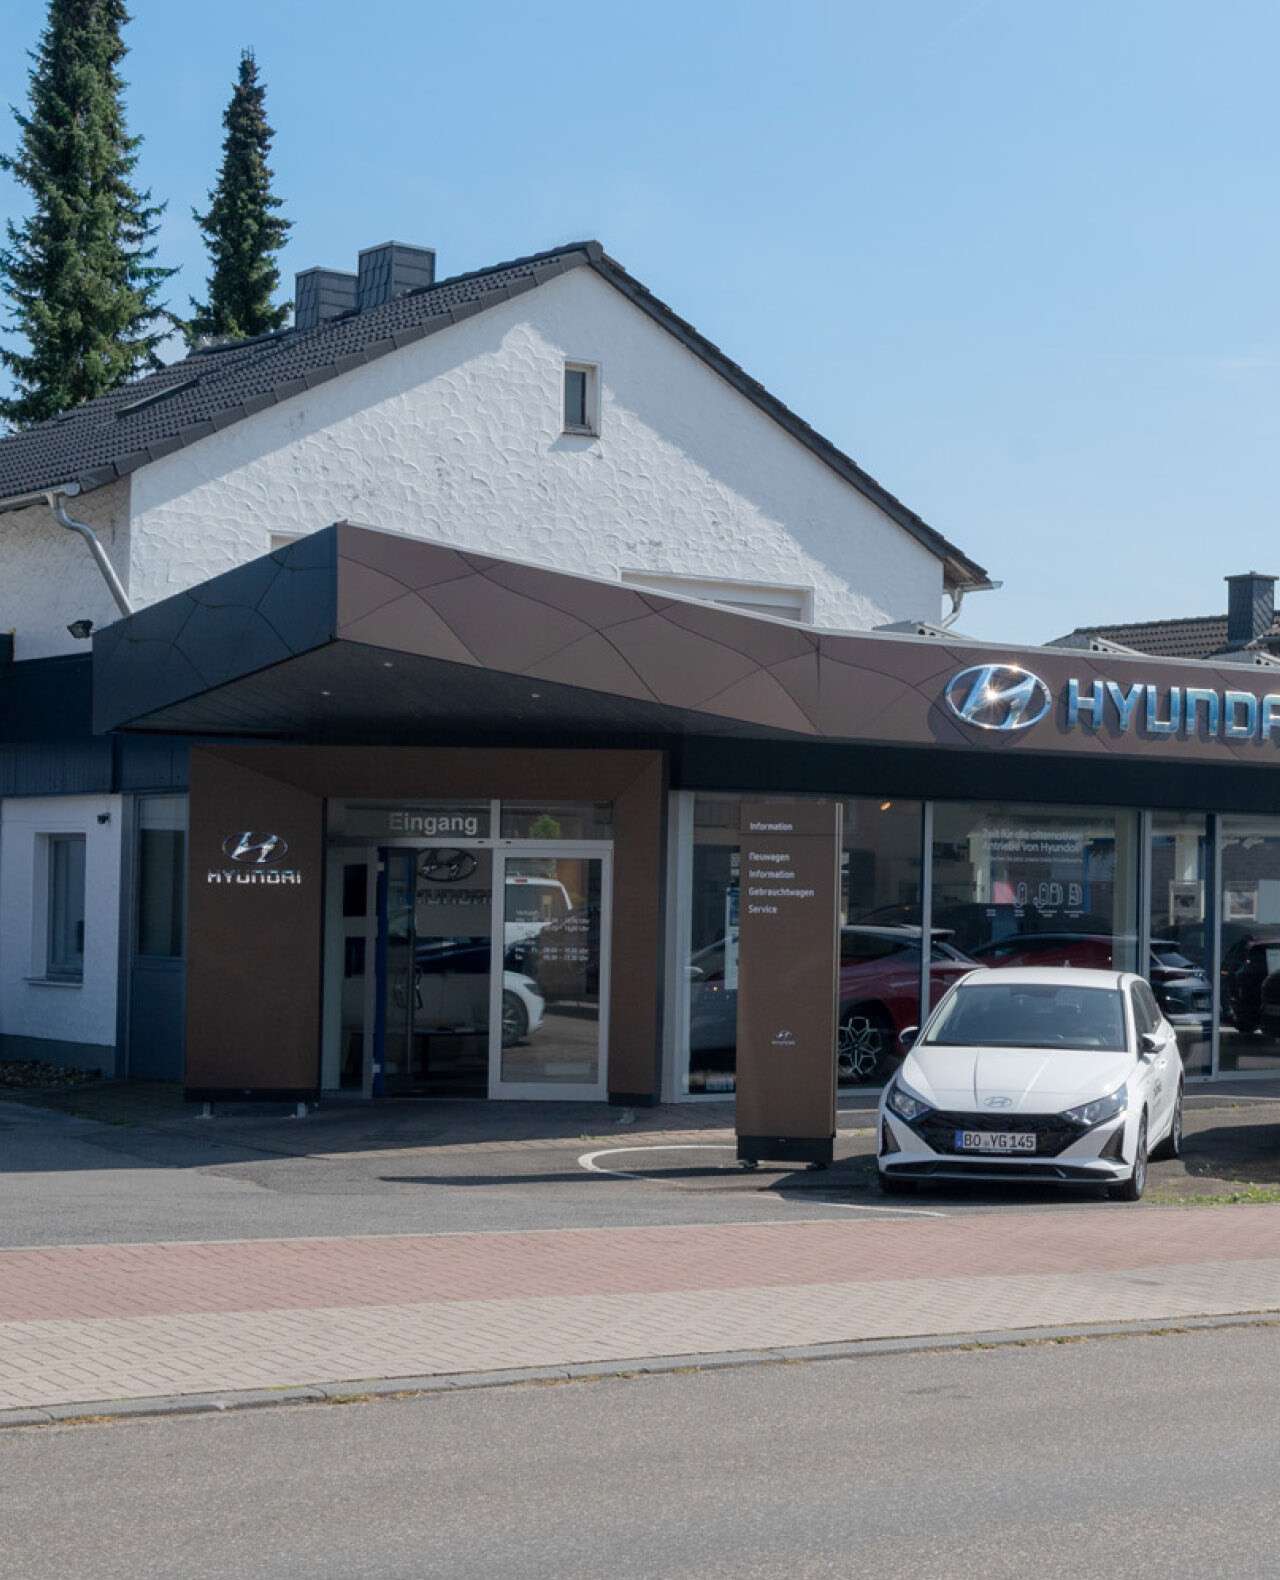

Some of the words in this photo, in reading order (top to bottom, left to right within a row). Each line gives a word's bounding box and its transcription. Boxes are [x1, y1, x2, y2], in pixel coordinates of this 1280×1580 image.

[389, 812, 478, 836] Eingang
[750, 822, 793, 831] Information
[207, 869, 302, 884] HYUNDAI
[748, 870, 795, 879] Information
[748, 904, 778, 914] Service
